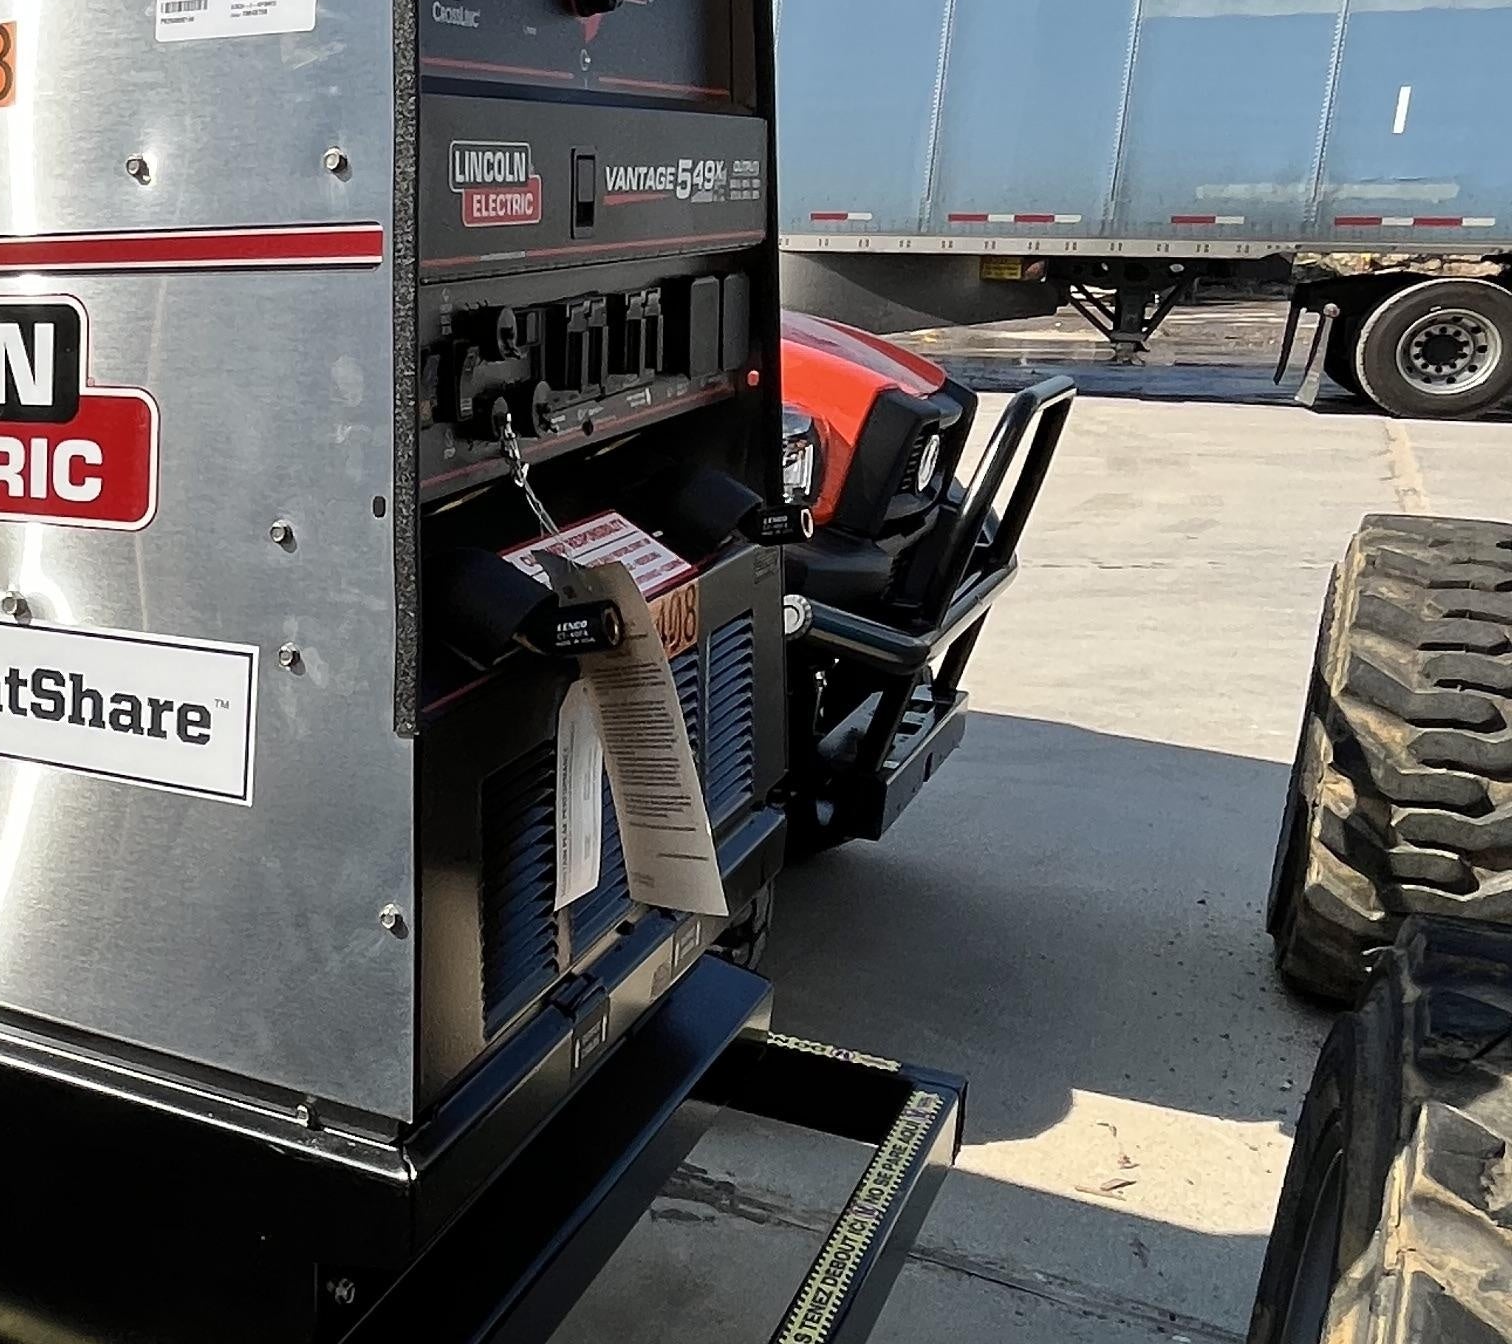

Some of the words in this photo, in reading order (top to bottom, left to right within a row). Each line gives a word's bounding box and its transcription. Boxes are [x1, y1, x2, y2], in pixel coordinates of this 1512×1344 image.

[455, 150, 526, 183] LINCOLN
[605, 166, 675, 191] VANTAGE
[472, 193, 534, 217] ELECTRIC
[798, 1286, 834, 1331] TENEZ
[820, 1235, 856, 1287] DEBOUT
